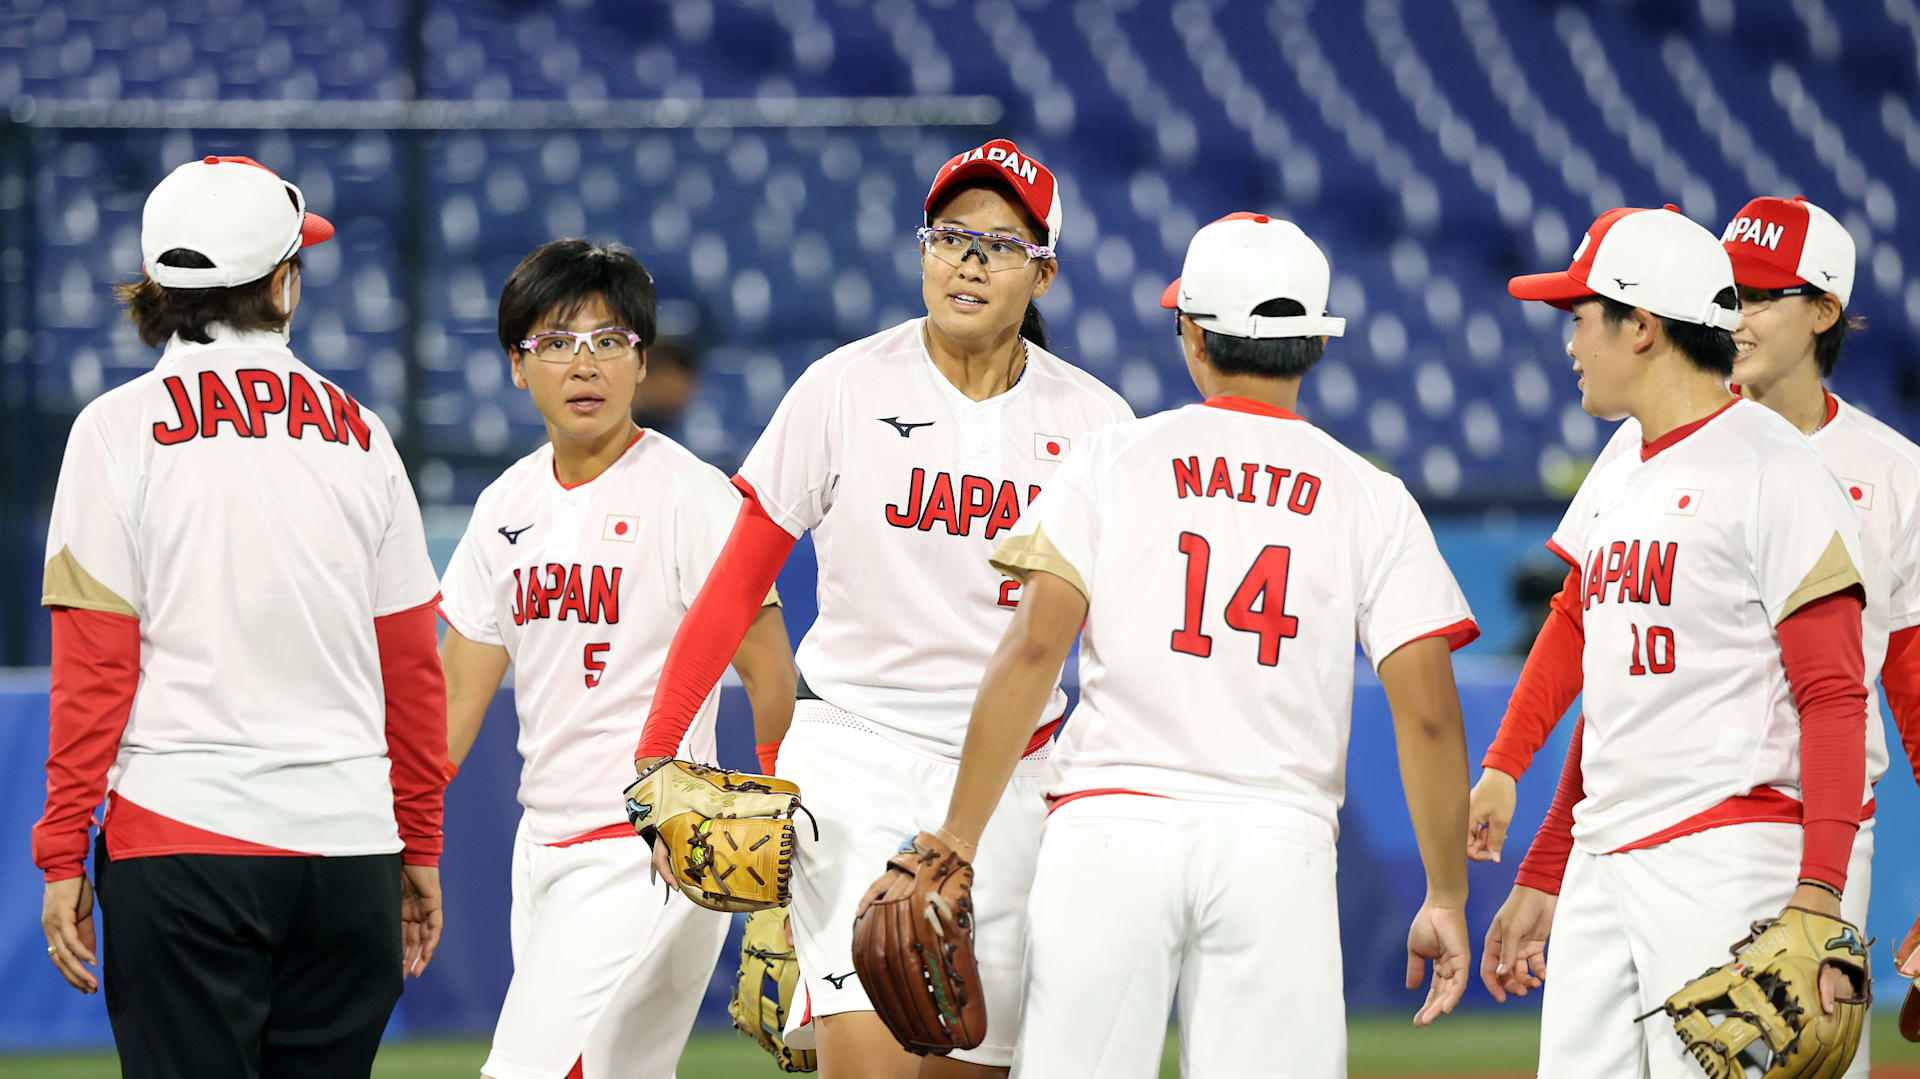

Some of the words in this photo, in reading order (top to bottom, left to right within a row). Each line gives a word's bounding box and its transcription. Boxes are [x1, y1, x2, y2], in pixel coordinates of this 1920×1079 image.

[951, 147, 1038, 186] JAPAN
[153, 369, 371, 452] JAPAN
[1172, 456, 1322, 515] NAITO
[511, 563, 623, 626] JAPAN
[1171, 531, 1299, 667] 14
[584, 642, 610, 689] 5
[1630, 623, 1676, 676] 10
